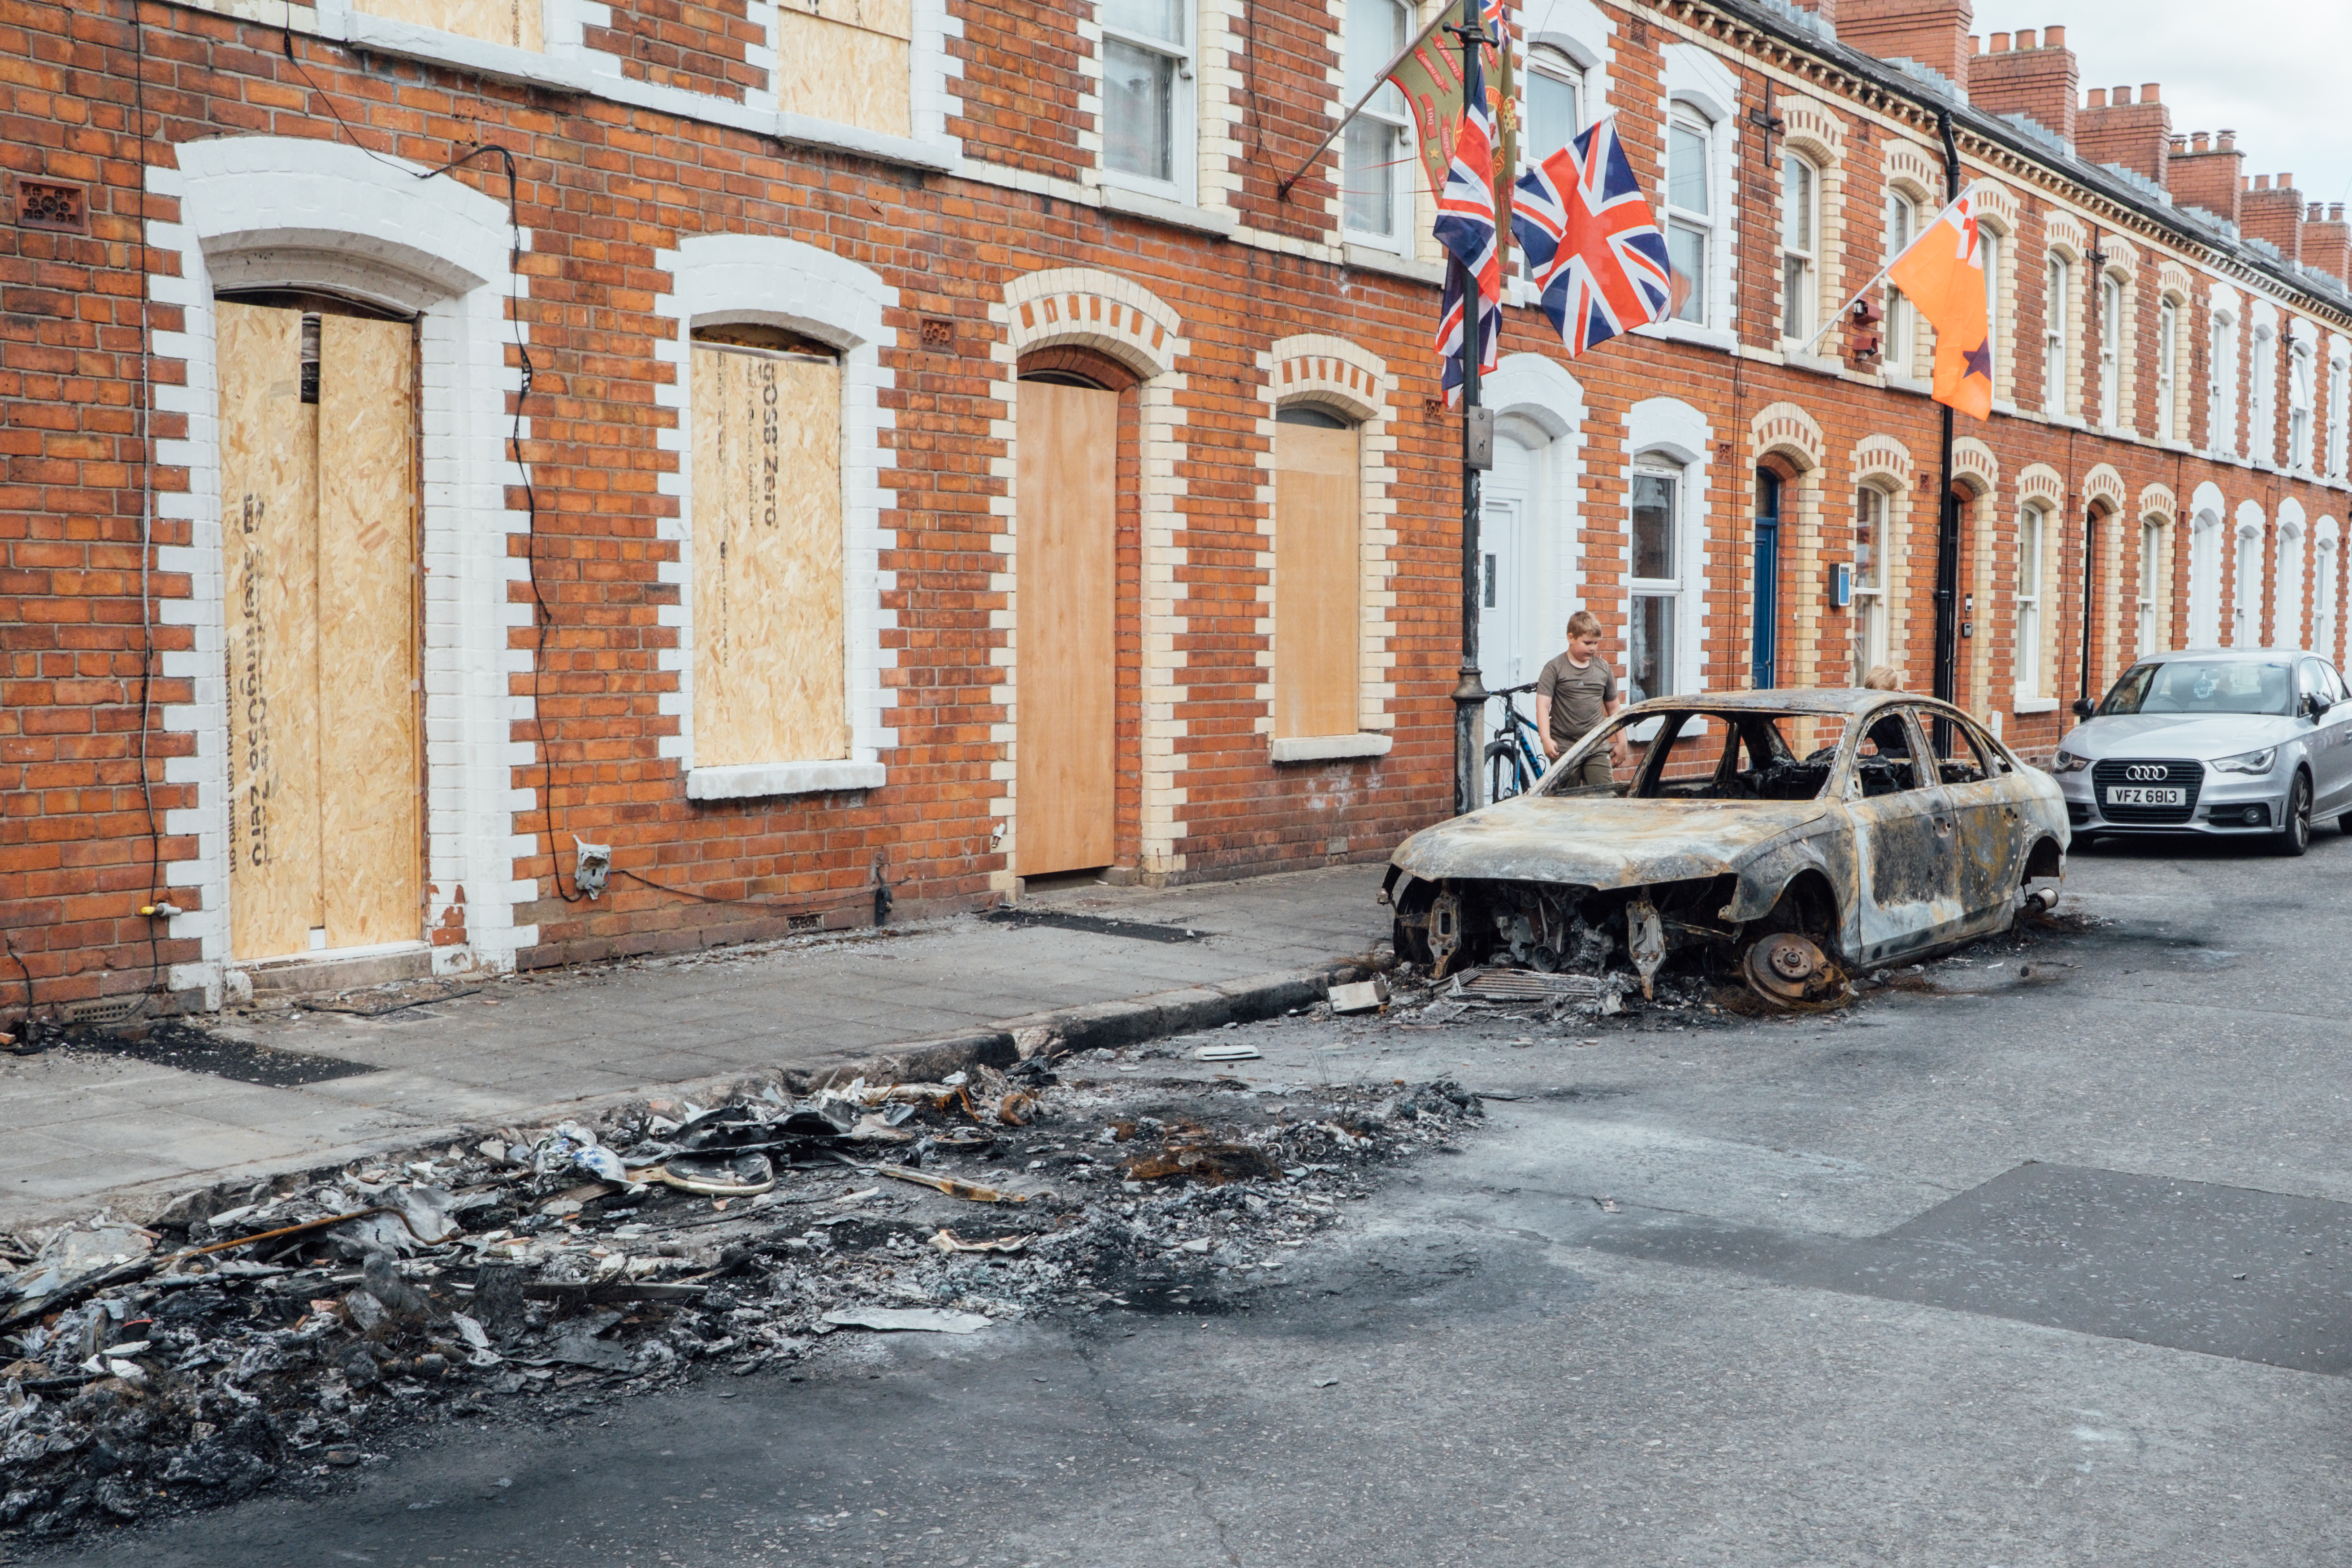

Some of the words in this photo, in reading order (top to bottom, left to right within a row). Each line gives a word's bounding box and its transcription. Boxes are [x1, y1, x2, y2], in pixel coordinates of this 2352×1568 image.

[1418, 54, 1437, 74] CAMBRAI
[1434, 74, 1443, 86] 1917
[1436, 42, 1452, 61] YPRES
[1450, 62, 1460, 77] 1917
[1426, 108, 1434, 125] 100
[764, 456, 779, 527] Zero
[2115, 789, 2141, 802] VFZ
[2146, 790, 2177, 803] 6813
[250, 780, 270, 867] Zero
[230, 845, 237, 873] on
